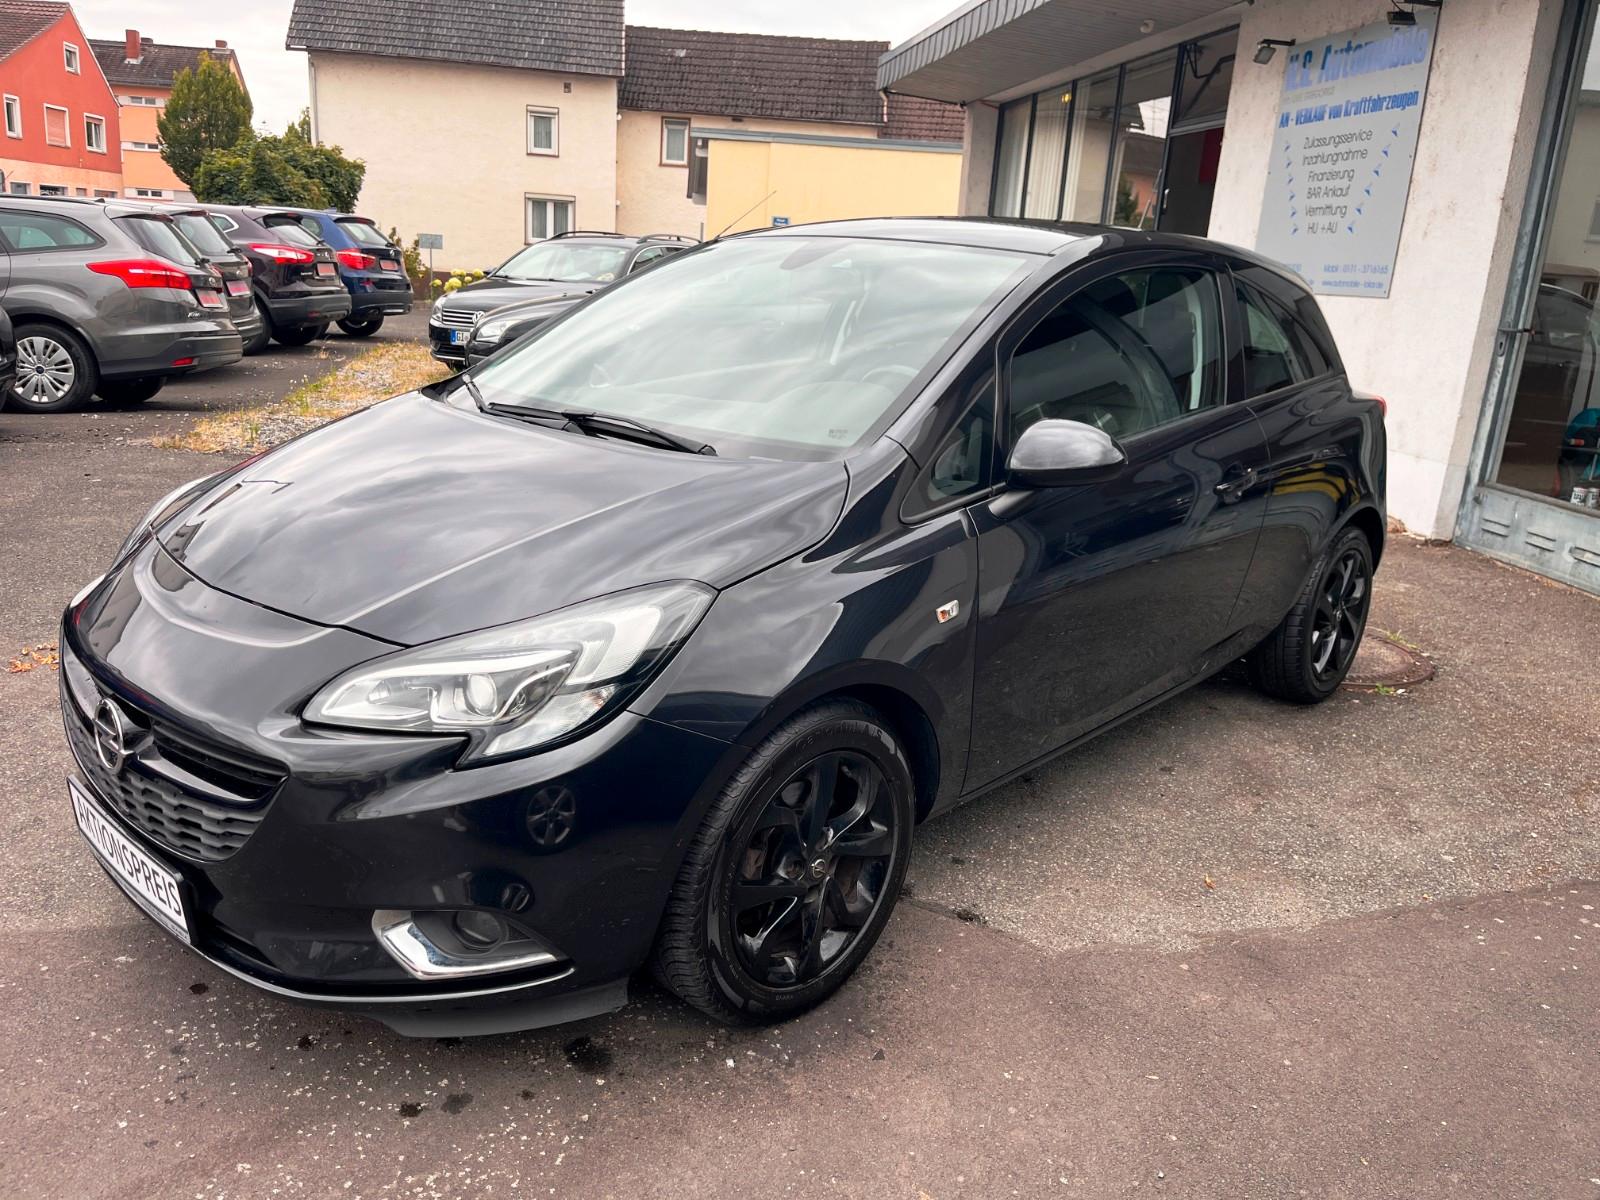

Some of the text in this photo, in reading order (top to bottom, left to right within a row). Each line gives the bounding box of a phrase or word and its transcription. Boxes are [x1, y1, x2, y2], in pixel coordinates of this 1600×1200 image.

[1343, 90, 1419, 118] Kraftfahrzeugen
[1303, 128, 1373, 150] Zulassungsservice
[1307, 167, 1355, 183] Finanzierung
[1306, 184, 1351, 200] BAR Ankauf
[1305, 203, 1348, 218] Vermittlung
[1307, 222, 1319, 235] HU
[1325, 221, 1338, 234] AU
[76, 794, 182, 917] AKTIONSPREIS
